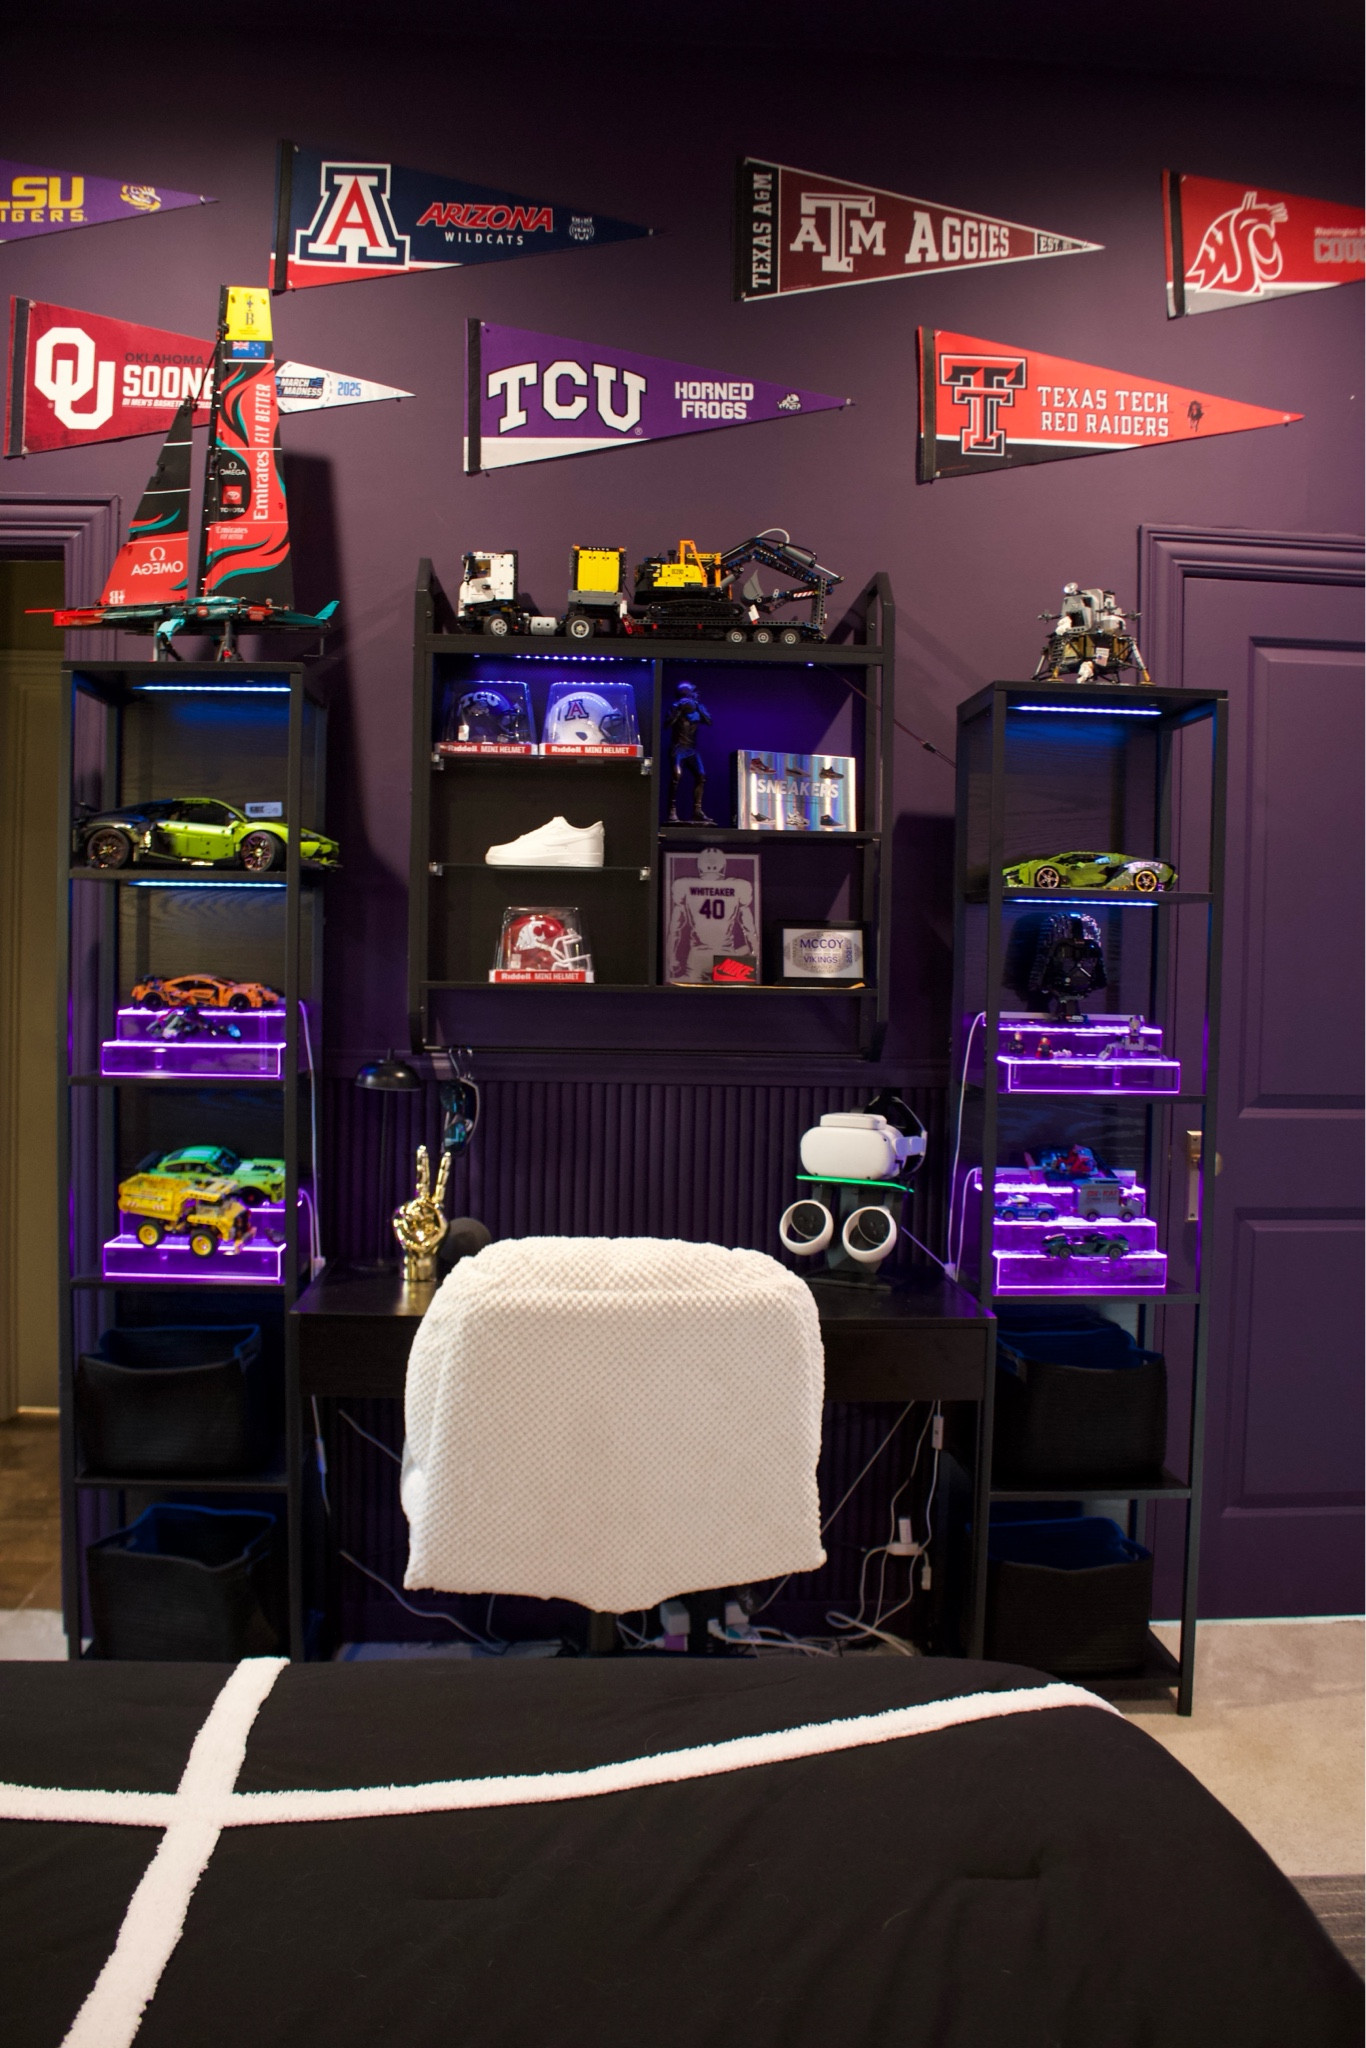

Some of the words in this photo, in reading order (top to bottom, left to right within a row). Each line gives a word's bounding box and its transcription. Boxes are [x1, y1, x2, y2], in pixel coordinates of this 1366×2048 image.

[752, 173, 772, 217] A&M
[0, 208, 84, 222] IGERS
[294, 161, 411, 271] A
[416, 202, 554, 232] ARIZONA
[445, 231, 524, 246] WILDCATS
[904, 211, 1010, 264] AGGIES
[752, 222, 772, 288] TEXAS
[246, 312, 255, 325] B
[124, 352, 204, 365] OKLAHOMA
[122, 364, 214, 400] SOONE
[281, 378, 310, 387] MARCH
[283, 386, 324, 397] MADNESS
[337, 382, 361, 397] 2025
[674, 381, 754, 401] HORNED
[254, 383, 271, 423] BETTER
[487, 360, 647, 434] TCU
[1037, 385, 1107, 410] TEXAS
[1115, 390, 1169, 413] TECH
[681, 401, 748, 420] FROGS
[1041, 411, 1078, 432] RED
[1085, 413, 1169, 437] RAIDERS
[254, 425, 270, 443] FLY
[219, 468, 247, 476] OMEGA
[253, 451, 270, 520] Emirates
[564, 699, 590, 721] A
[448, 744, 478, 753] Riddell
[499, 746, 526, 754] HELMET
[551, 745, 581, 754] Riddell
[584, 746, 602, 754] MINI
[602, 747, 630, 755] HELMET
[757, 779, 839, 799] SNEAKERS
[689, 887, 735, 897] WHITEAKER
[699, 899, 725, 920] 40
[800, 939, 844, 949] MCCOY
[803, 956, 838, 964] VIKINGS
[501, 972, 531, 980] Riddell
[553, 973, 579, 981] HELMET
